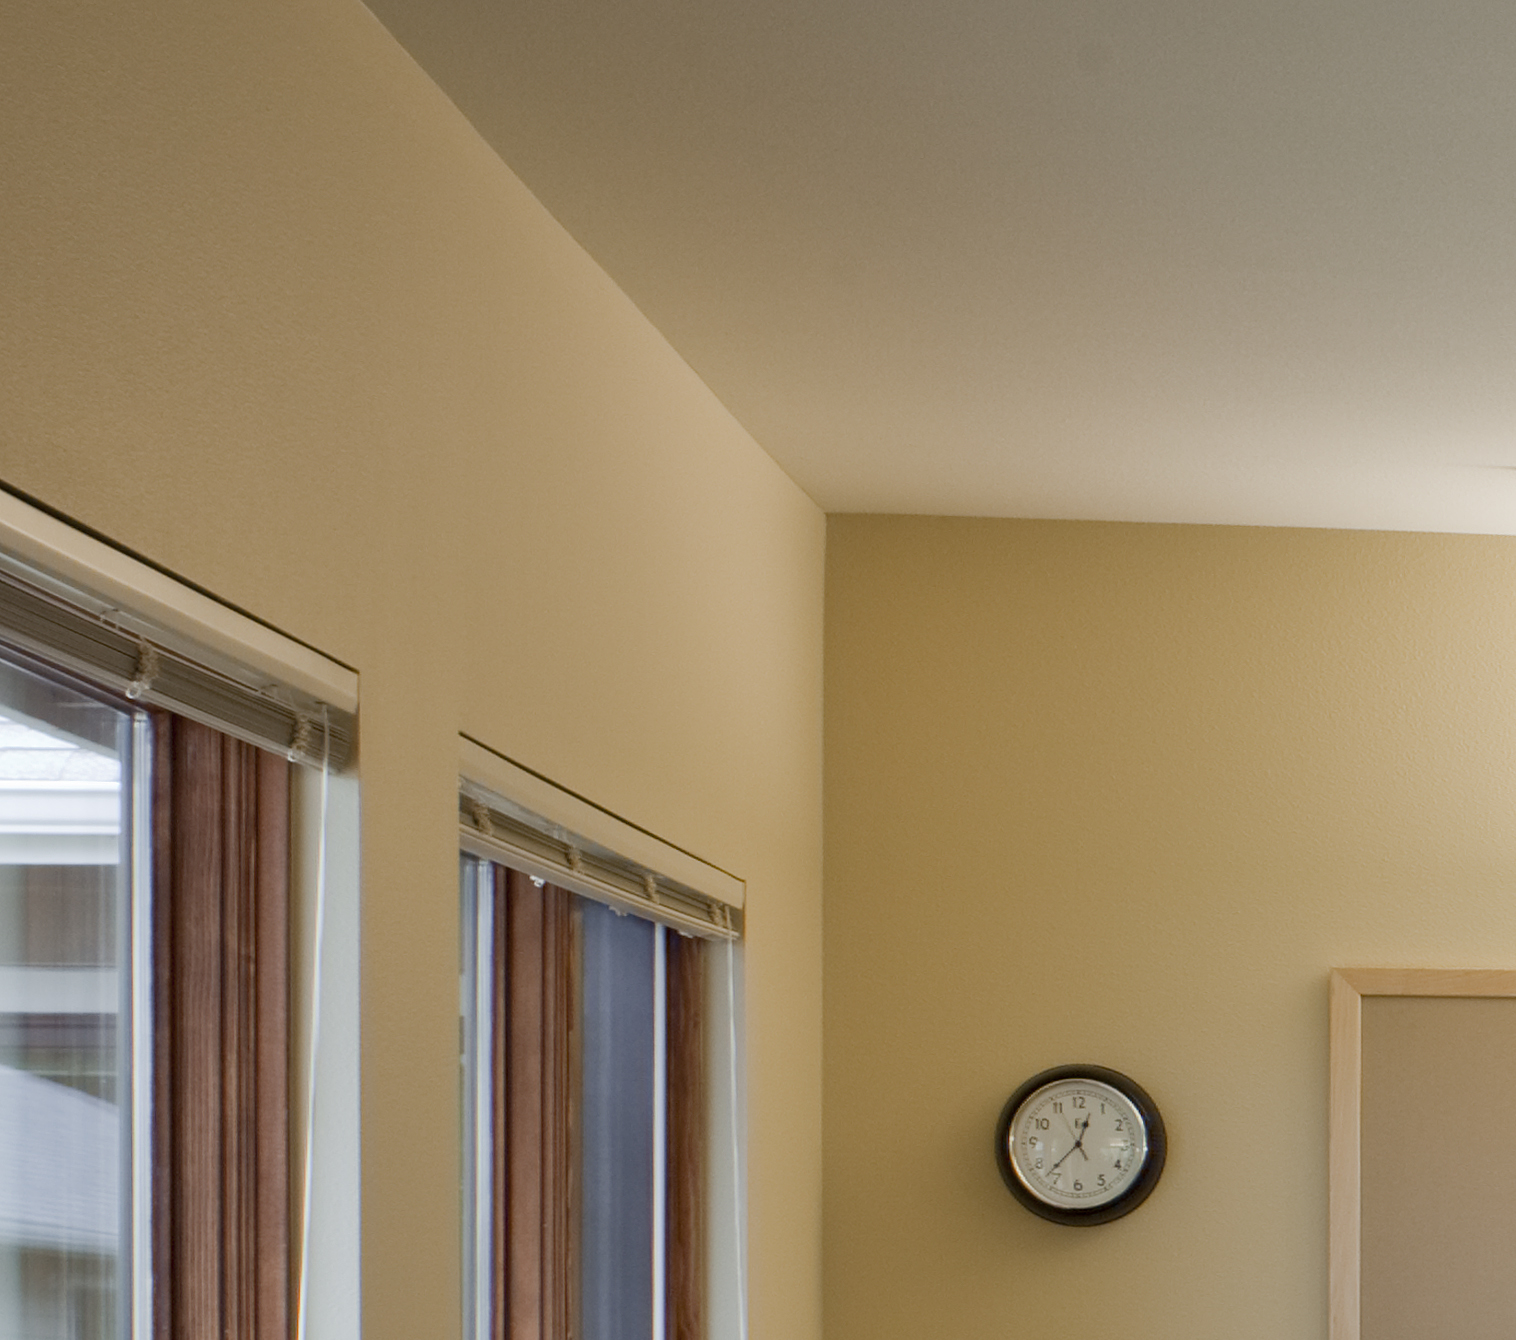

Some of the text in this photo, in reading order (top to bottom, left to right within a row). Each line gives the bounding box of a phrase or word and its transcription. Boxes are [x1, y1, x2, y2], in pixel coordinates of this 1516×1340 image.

[1053, 1103, 1063, 1114] 11
[1072, 1097, 1086, 1109] 12
[1101, 1103, 1105, 1114] 1
[1036, 1118, 1049, 1130] 10
[1116, 1119, 1123, 1131] 2
[1029, 1137, 1038, 1148] 9
[1114, 1160, 1122, 1170] 4
[1073, 1179, 1083, 1191] 6
[1097, 1174, 1106, 1186] 5
